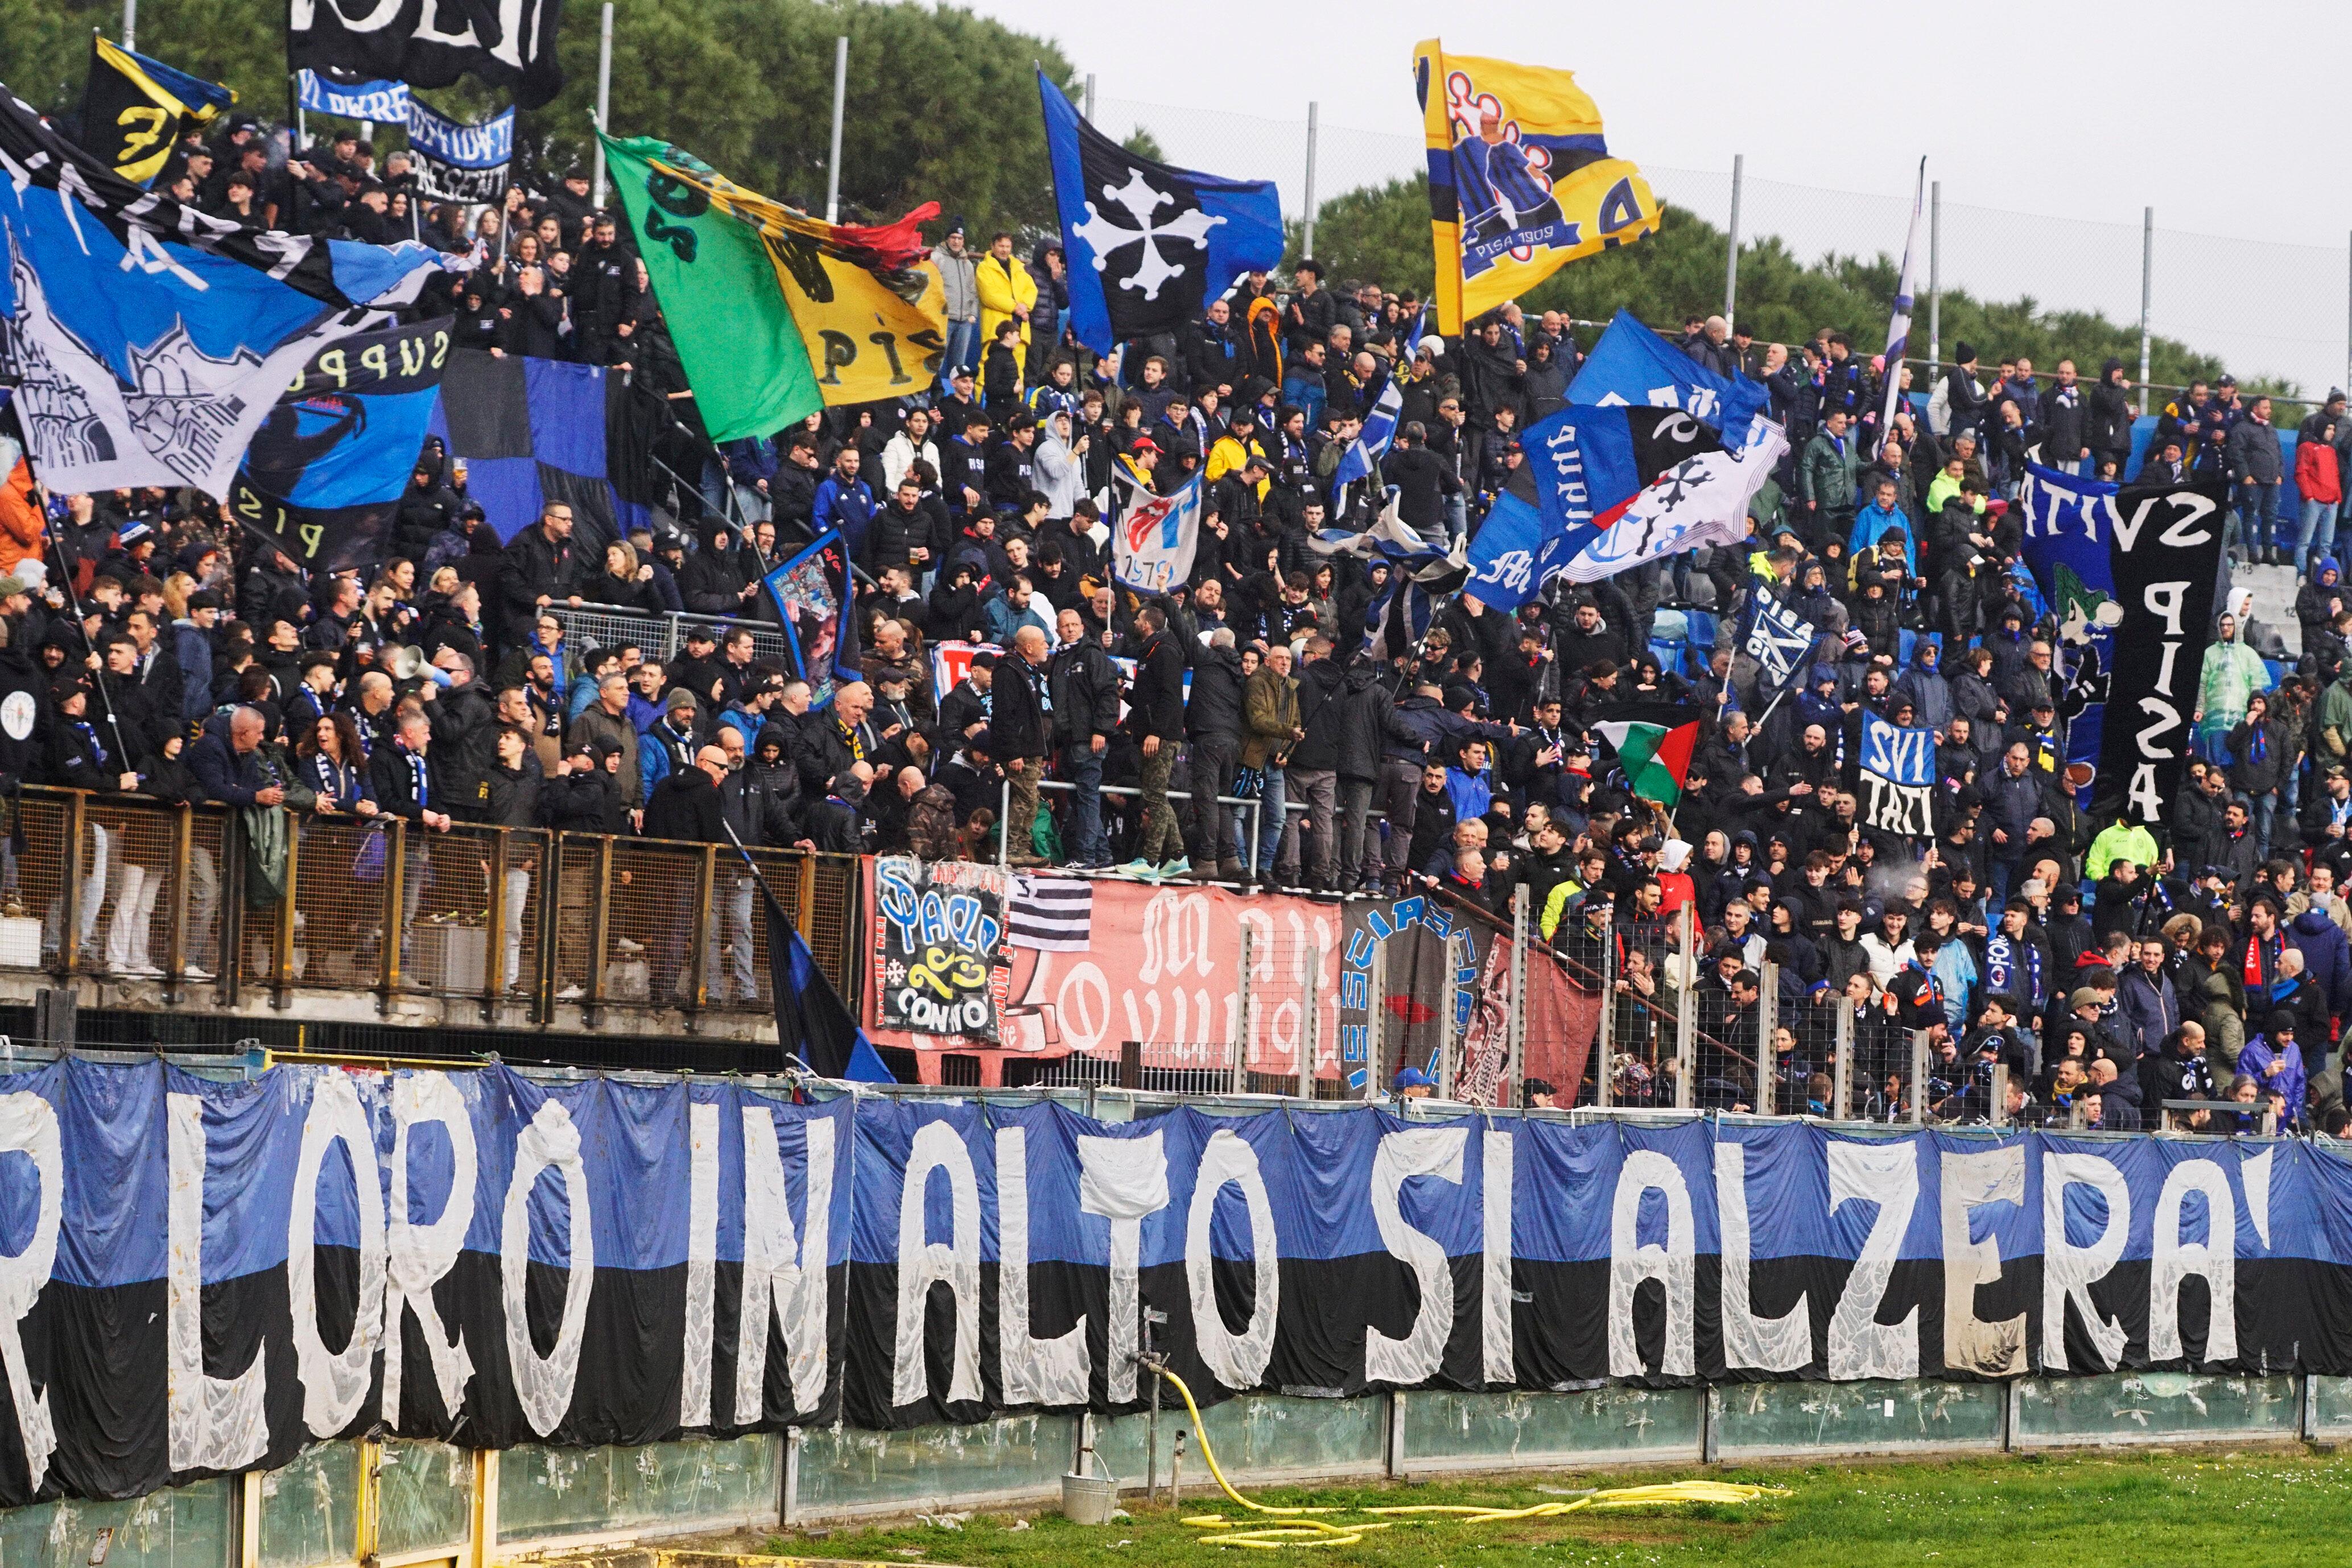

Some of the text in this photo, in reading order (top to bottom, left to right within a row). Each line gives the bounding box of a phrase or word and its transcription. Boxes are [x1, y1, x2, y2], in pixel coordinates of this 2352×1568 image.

[1475, 225, 1554, 257] PISA 1909
[1757, 585, 1814, 643] PISA
[167, 1066, 593, 1472] LORO
[680, 1103, 835, 1426] IN
[893, 1119, 1278, 1408] ALTO
[1365, 1127, 1516, 1385] SI
[1608, 1140, 2274, 1381] ALZERA'
